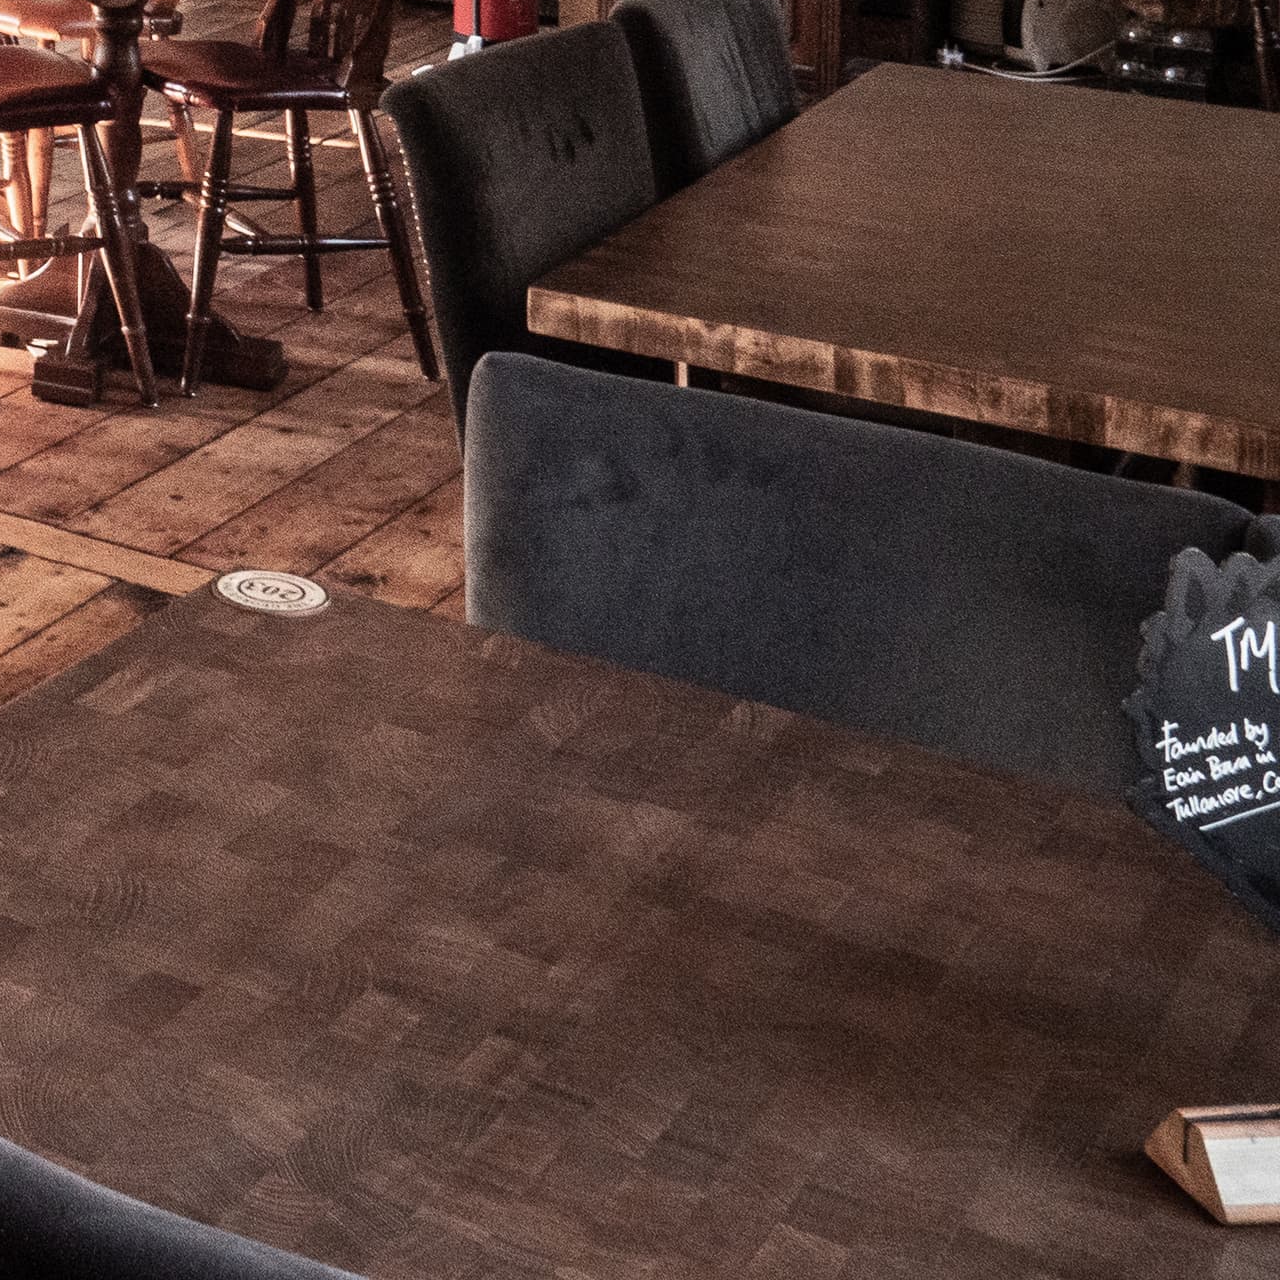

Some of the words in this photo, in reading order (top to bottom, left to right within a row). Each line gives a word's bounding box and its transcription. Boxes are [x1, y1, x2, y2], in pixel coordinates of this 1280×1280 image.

[1155, 720, 1239, 763] Founded
[1243, 717, 1270, 748] by
[1255, 746, 1277, 764] in
